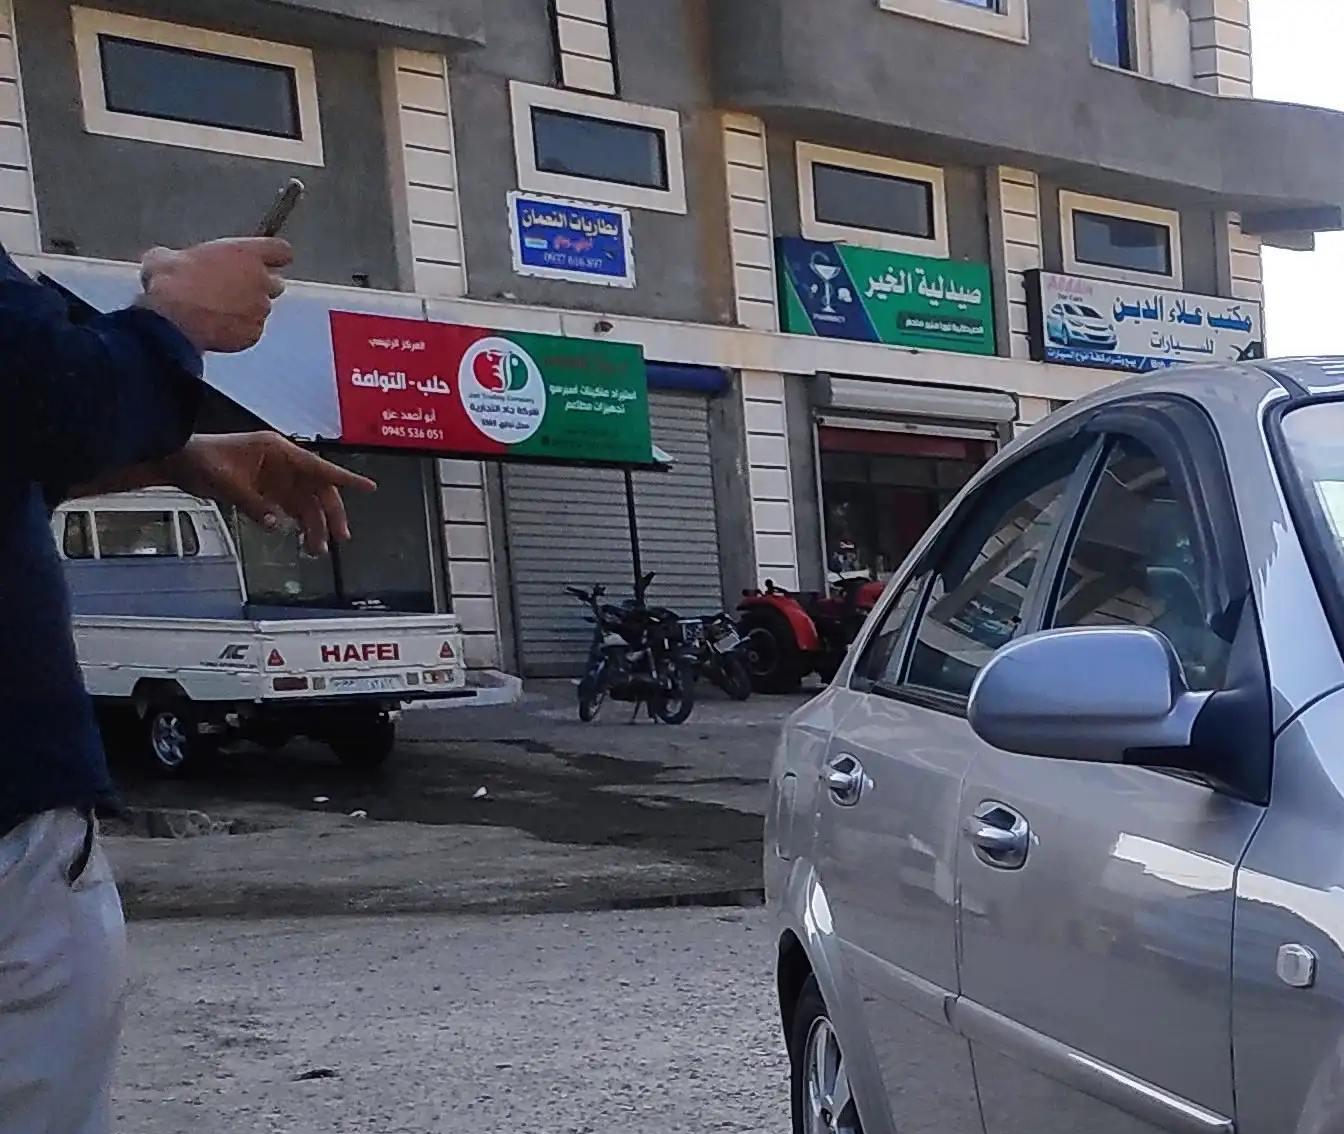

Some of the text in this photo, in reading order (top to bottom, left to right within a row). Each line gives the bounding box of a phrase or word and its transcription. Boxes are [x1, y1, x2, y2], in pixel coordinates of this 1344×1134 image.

[522, 208, 619, 240] بطاريات النعمان
[864, 266, 982, 310] صيدلية الخير
[1112, 295, 1253, 334] مكتب علاء الدين
[1150, 331, 1214, 355] للسيارات
[416, 375, 451, 397] حلب
[382, 425, 444, 440] 0945 536 051
[321, 643, 399, 663] HAFEI
